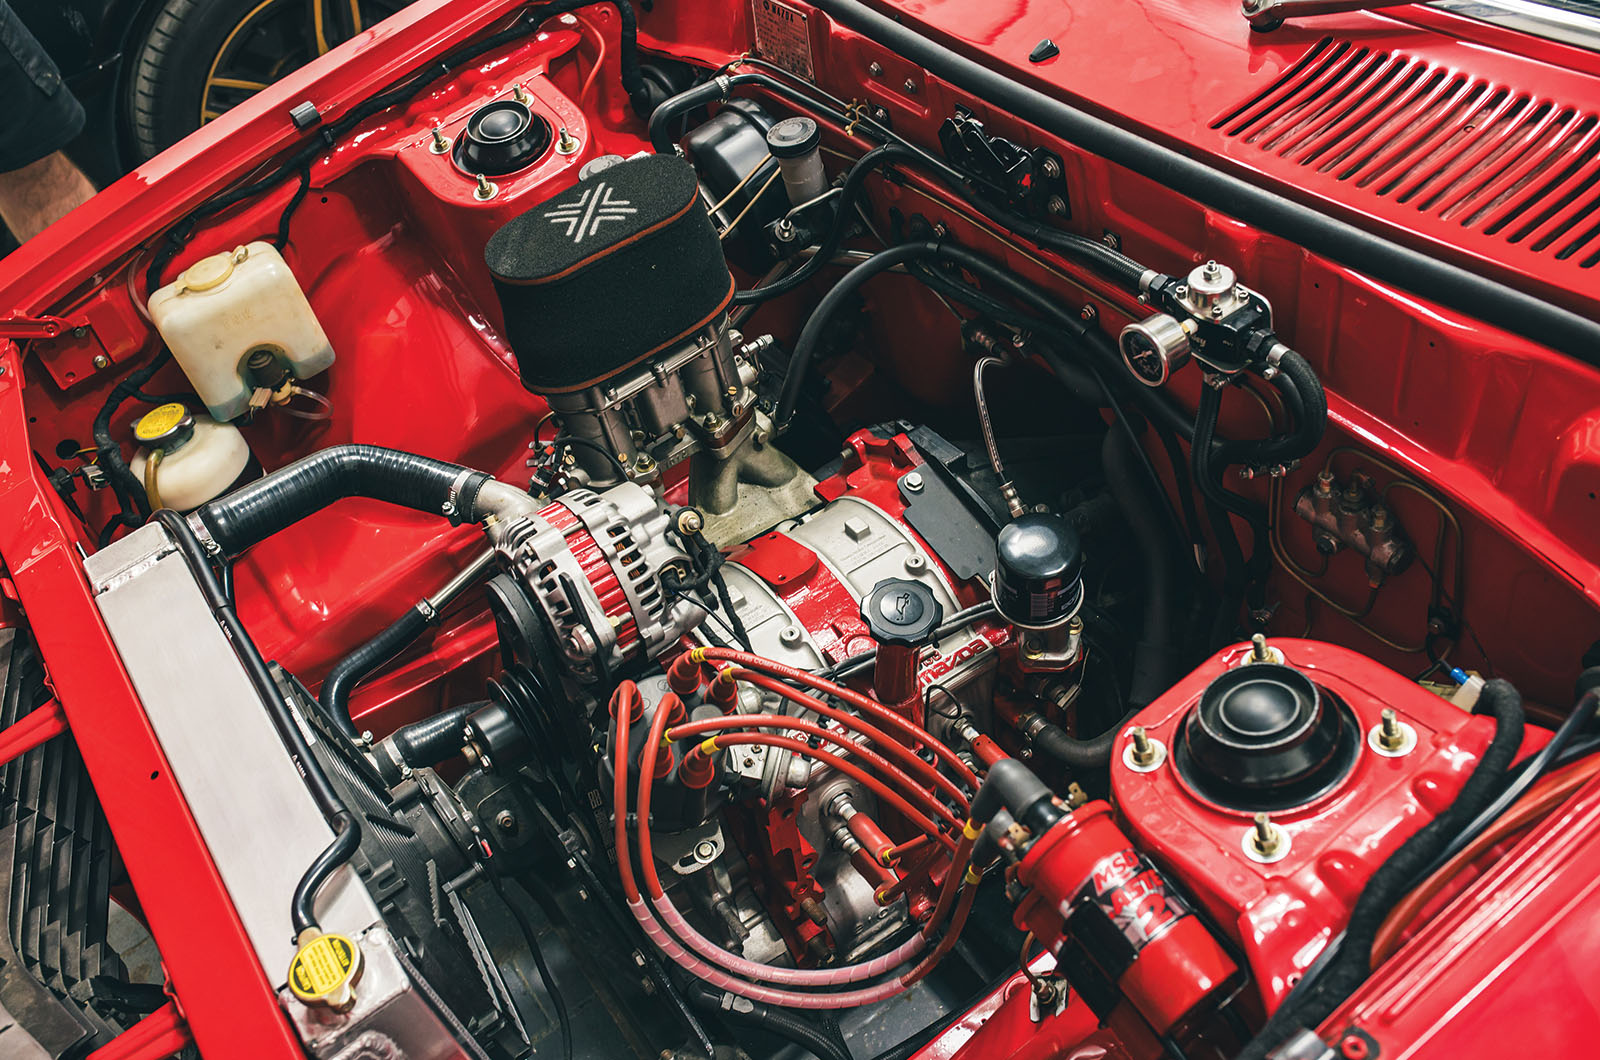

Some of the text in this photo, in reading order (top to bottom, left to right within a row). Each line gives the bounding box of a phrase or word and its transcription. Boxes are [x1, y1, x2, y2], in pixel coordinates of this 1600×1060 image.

[753, 657, 801, 677] COMPETITION
[919, 639, 990, 688] mazda
[1093, 848, 1139, 893] MSD
[1136, 892, 1175, 937] 2
